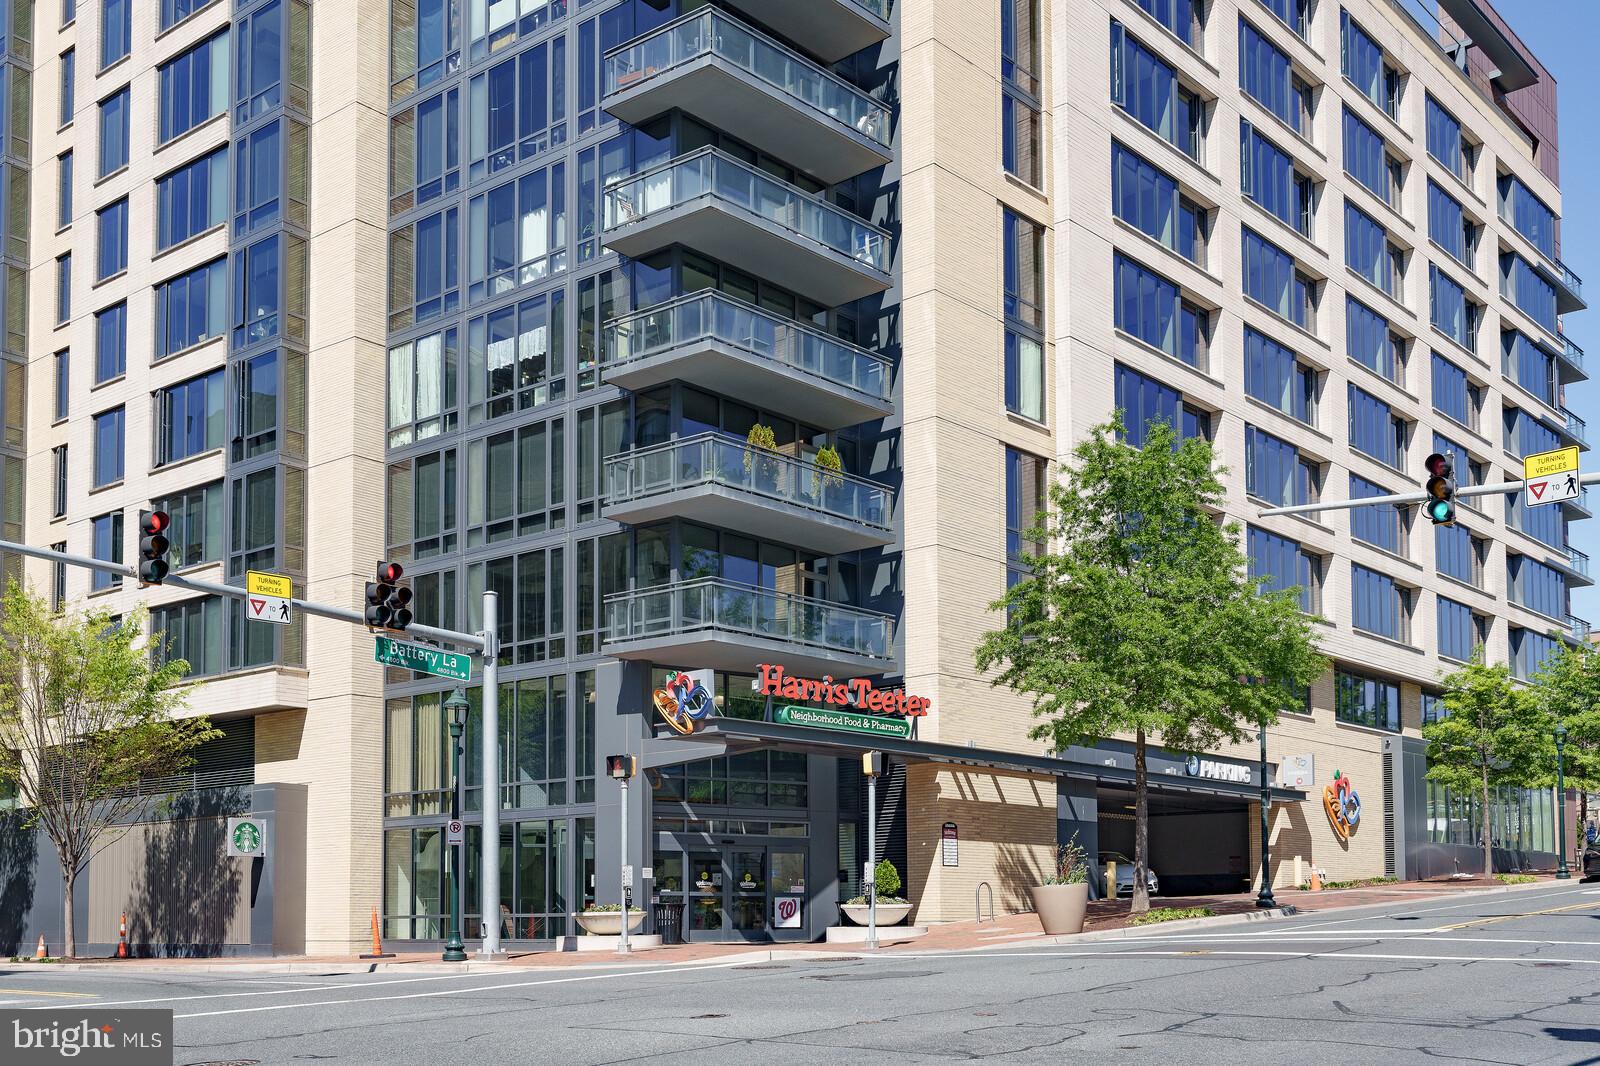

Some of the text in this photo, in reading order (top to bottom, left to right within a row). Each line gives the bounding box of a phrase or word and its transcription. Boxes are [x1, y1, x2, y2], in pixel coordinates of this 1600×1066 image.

[1537, 453, 1566, 465] TURNING
[1535, 461, 1567, 474] VEHICLES
[1552, 483, 1560, 491] TO
[257, 576, 282, 587] TURNING
[256, 584, 283, 594] VEHICLES
[269, 605, 277, 613] TO
[389, 640, 457, 668] Battery La
[436, 666, 451, 675] 4800
[759, 663, 931, 717] Harris Teeter
[790, 709, 907, 735] Neighborhood Food & Pharmacy
[1199, 759, 1251, 784] PARKING
